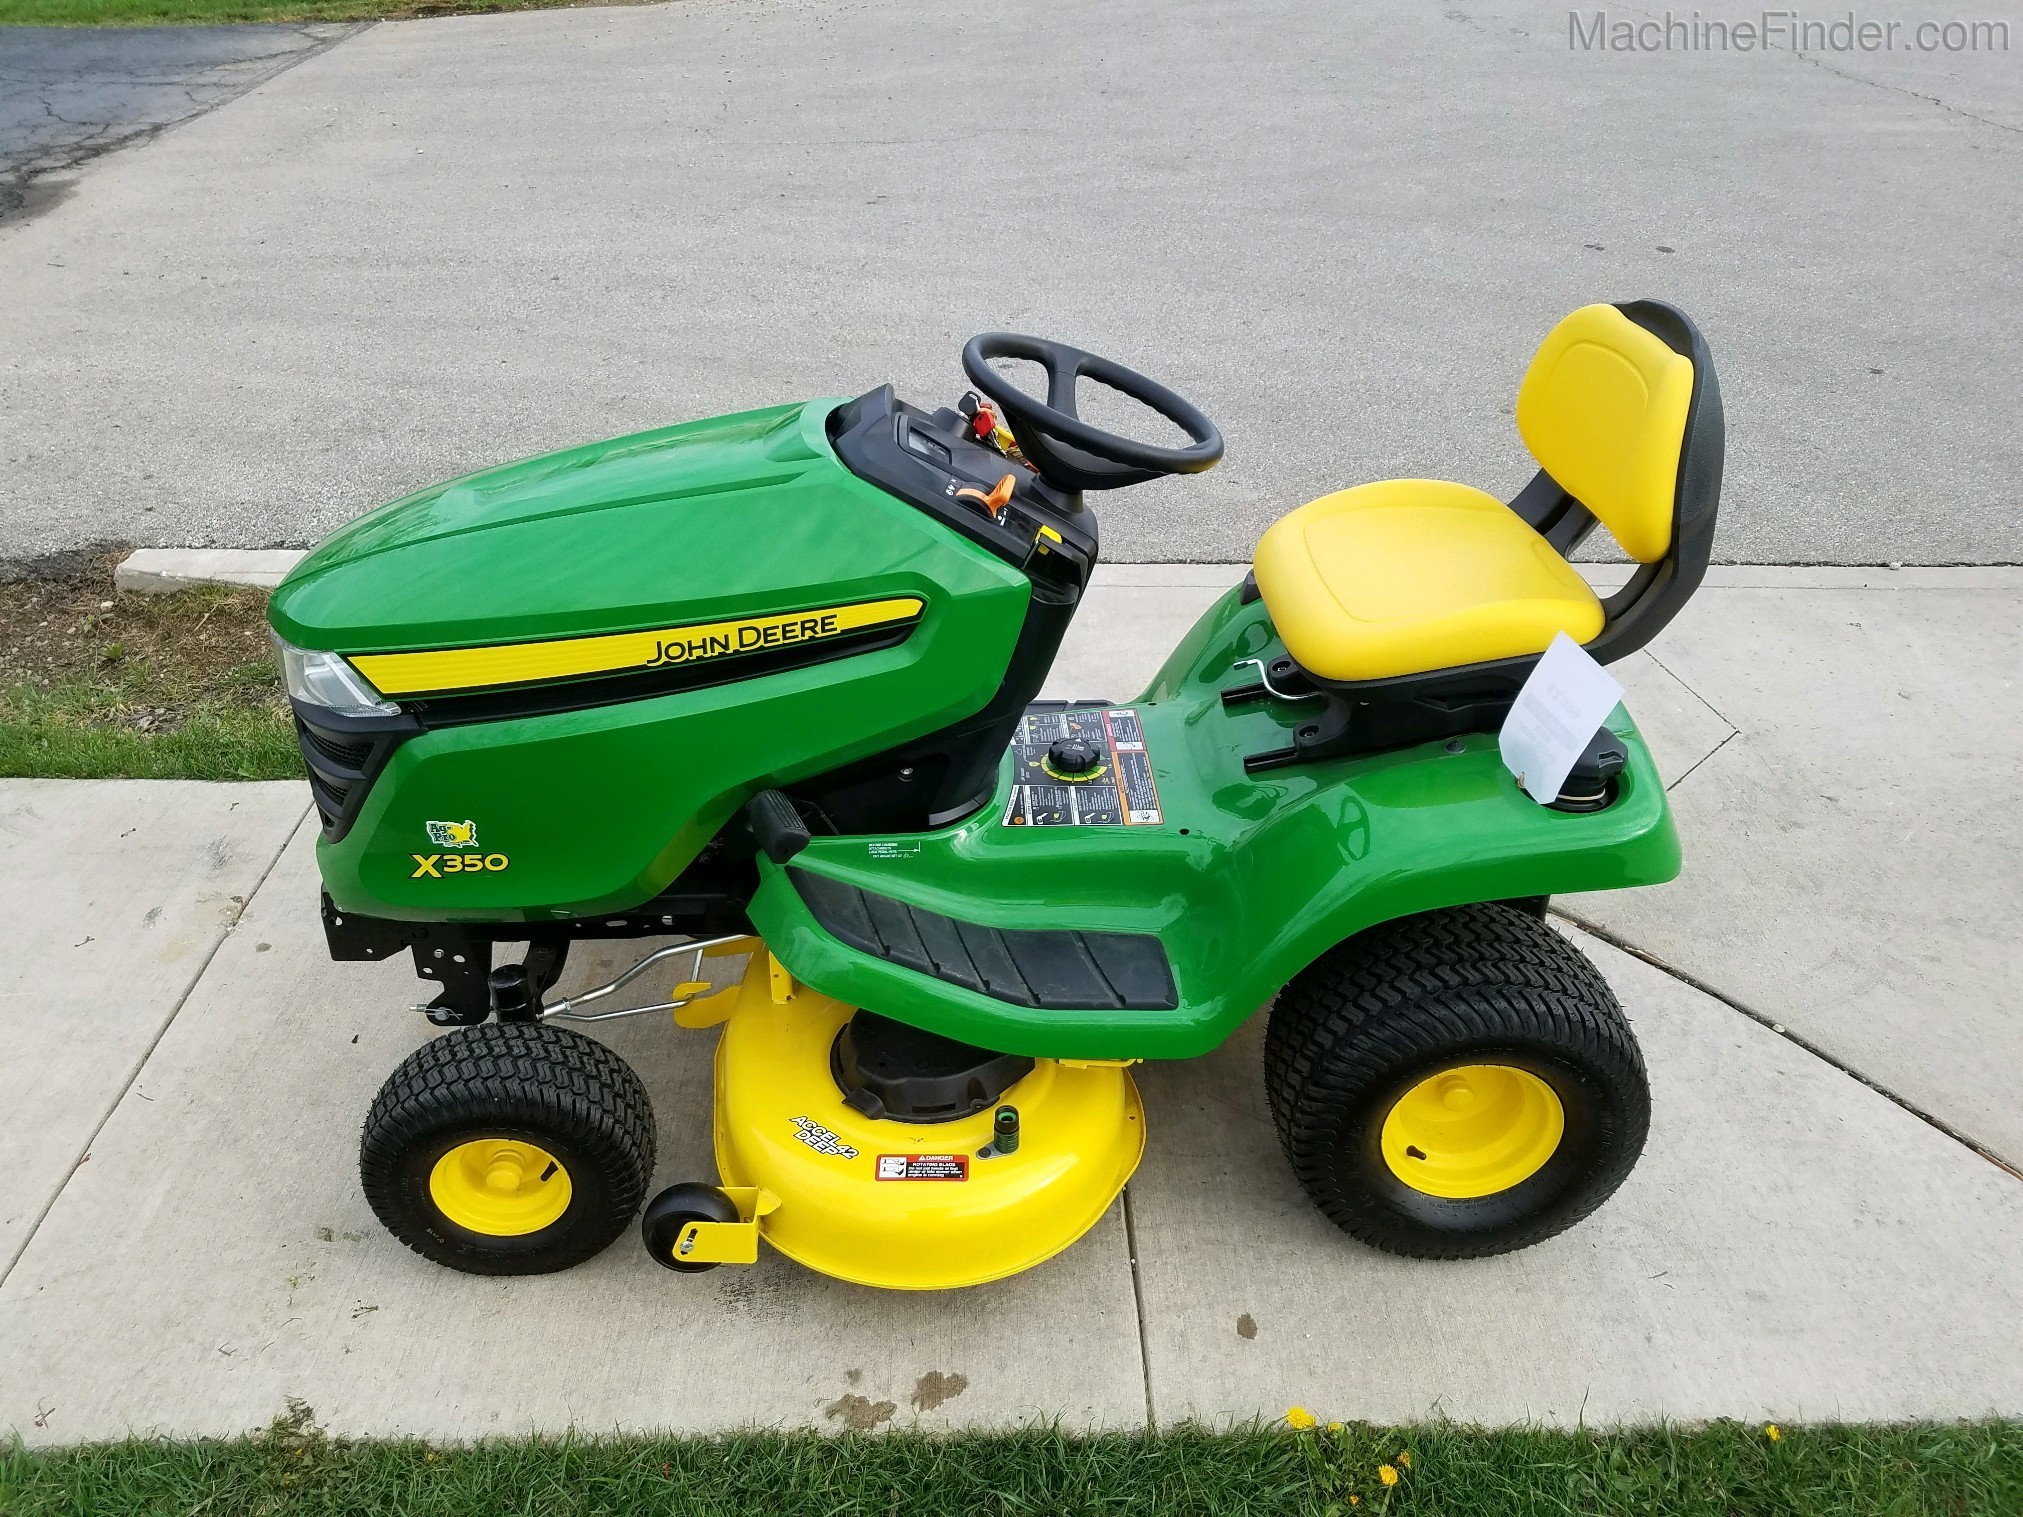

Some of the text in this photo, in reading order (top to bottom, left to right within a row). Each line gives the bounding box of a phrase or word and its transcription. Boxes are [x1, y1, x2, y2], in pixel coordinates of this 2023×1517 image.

[646, 614, 838, 665] JOHN DEERE
[408, 853, 510, 879] X350
[788, 1115, 842, 1147] ACCEL
[793, 1129, 839, 1155] DEEP
